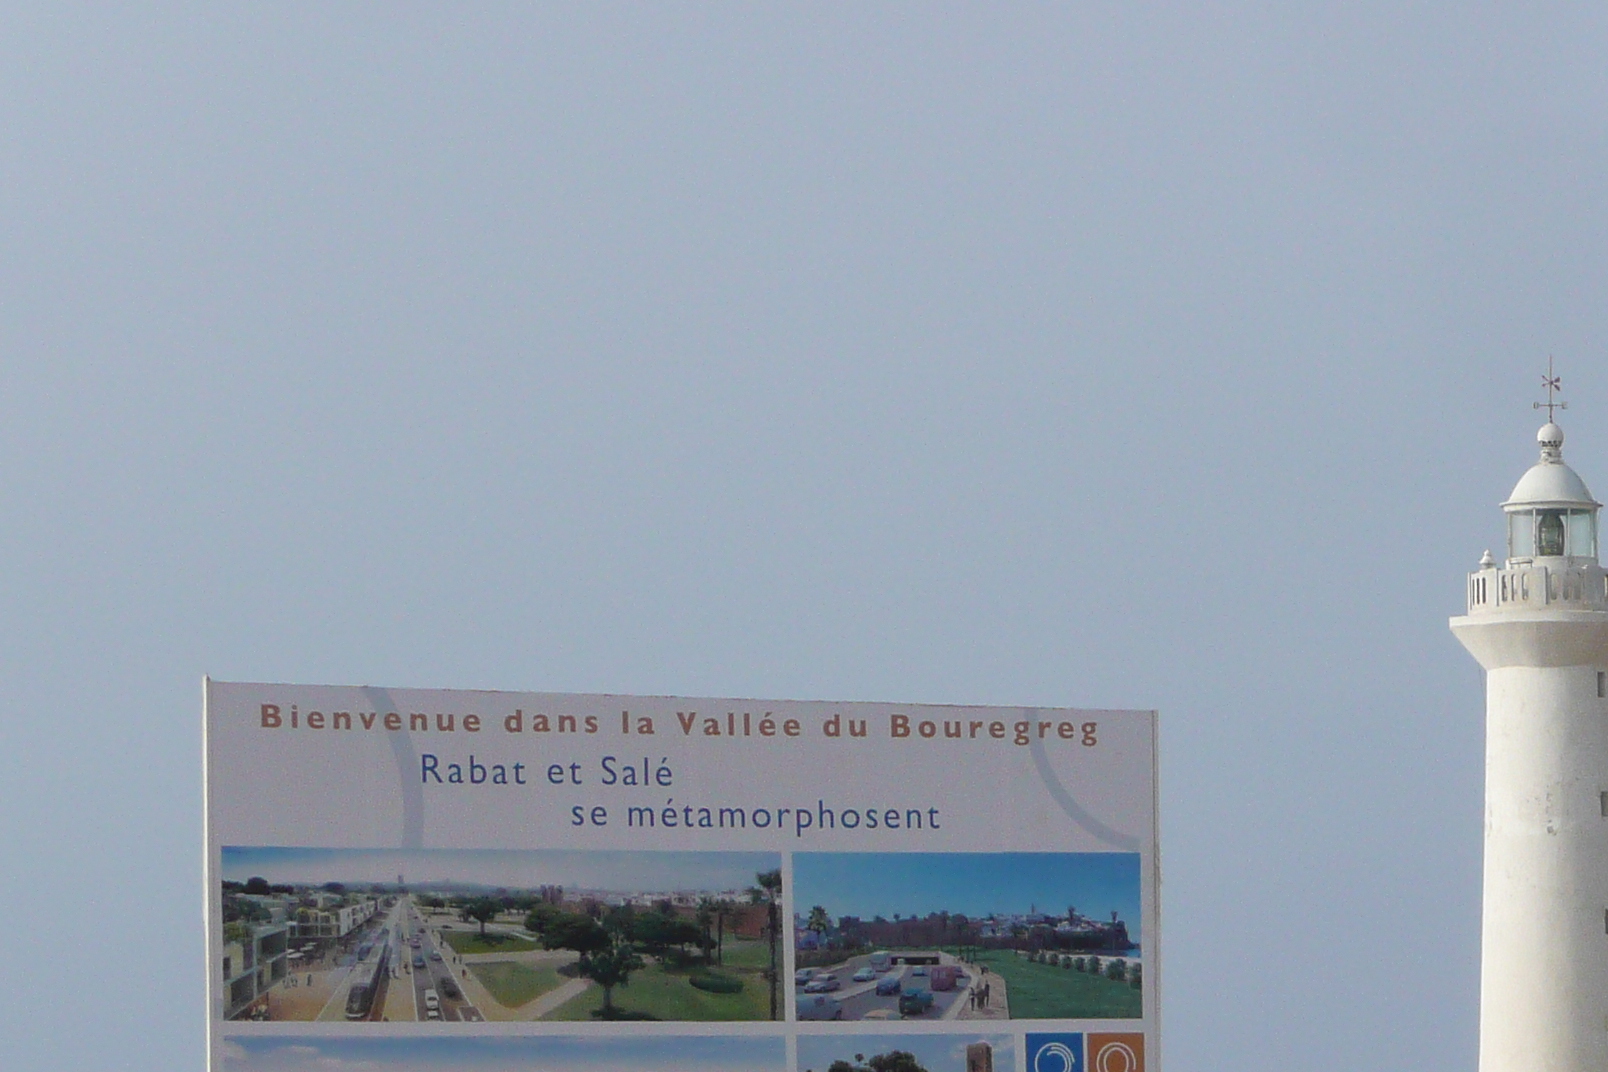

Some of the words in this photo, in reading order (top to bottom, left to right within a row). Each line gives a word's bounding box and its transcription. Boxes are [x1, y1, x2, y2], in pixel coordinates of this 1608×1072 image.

[260, 703, 482, 733] Bienvenue
[503, 709, 599, 734] dans
[621, 710, 655, 735] la
[676, 711, 801, 737] Vallée
[822, 713, 868, 738] du
[890, 714, 1098, 747] Bouregreg
[421, 753, 527, 786] Rabat
[546, 756, 583, 786] et
[601, 755, 673, 787] Salé
[571, 805, 608, 827] se
[628, 798, 941, 837] métamorphosent
